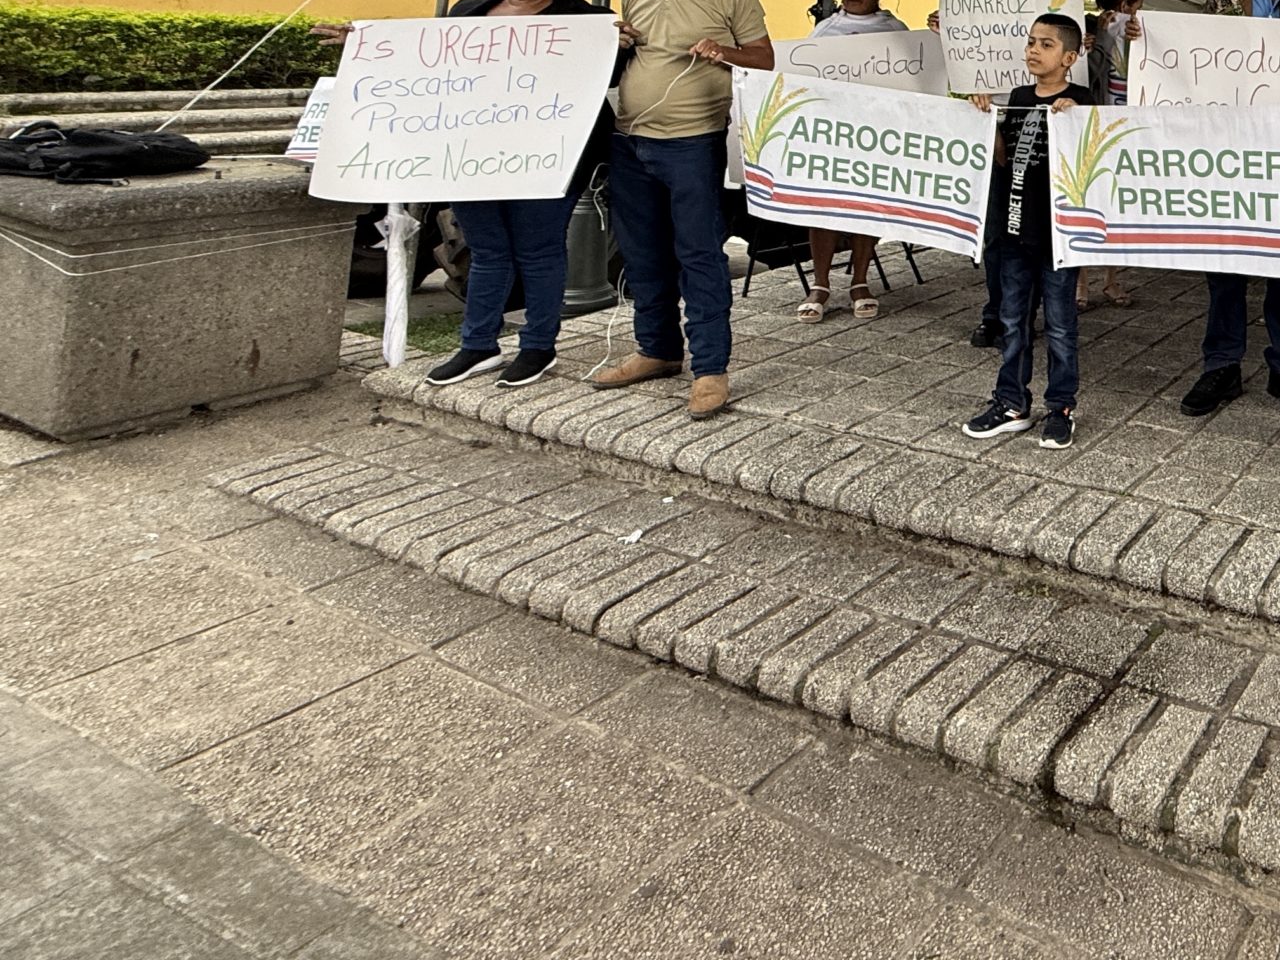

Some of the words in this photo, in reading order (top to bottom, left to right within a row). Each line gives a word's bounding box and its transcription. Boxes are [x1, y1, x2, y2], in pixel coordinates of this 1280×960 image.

[352, 24, 395, 62] Es
[418, 24, 571, 69] URGENTE
[946, 20, 1030, 48] resguarda
[947, 45, 1013, 63] nuestra
[1140, 16, 1179, 71] La
[789, 42, 924, 82] Seguridad
[353, 69, 487, 103] rescatar
[506, 66, 538, 94] la
[536, 93, 574, 121] de
[337, 142, 434, 180] Arroz
[442, 135, 565, 182] Nacional
[787, 115, 988, 172] ARROCEROS
[1014, 120, 1038, 165] RULES
[786, 151, 972, 206] PRESENTES
[1011, 168, 1025, 191] THE
[1007, 193, 1023, 236] FORGET
